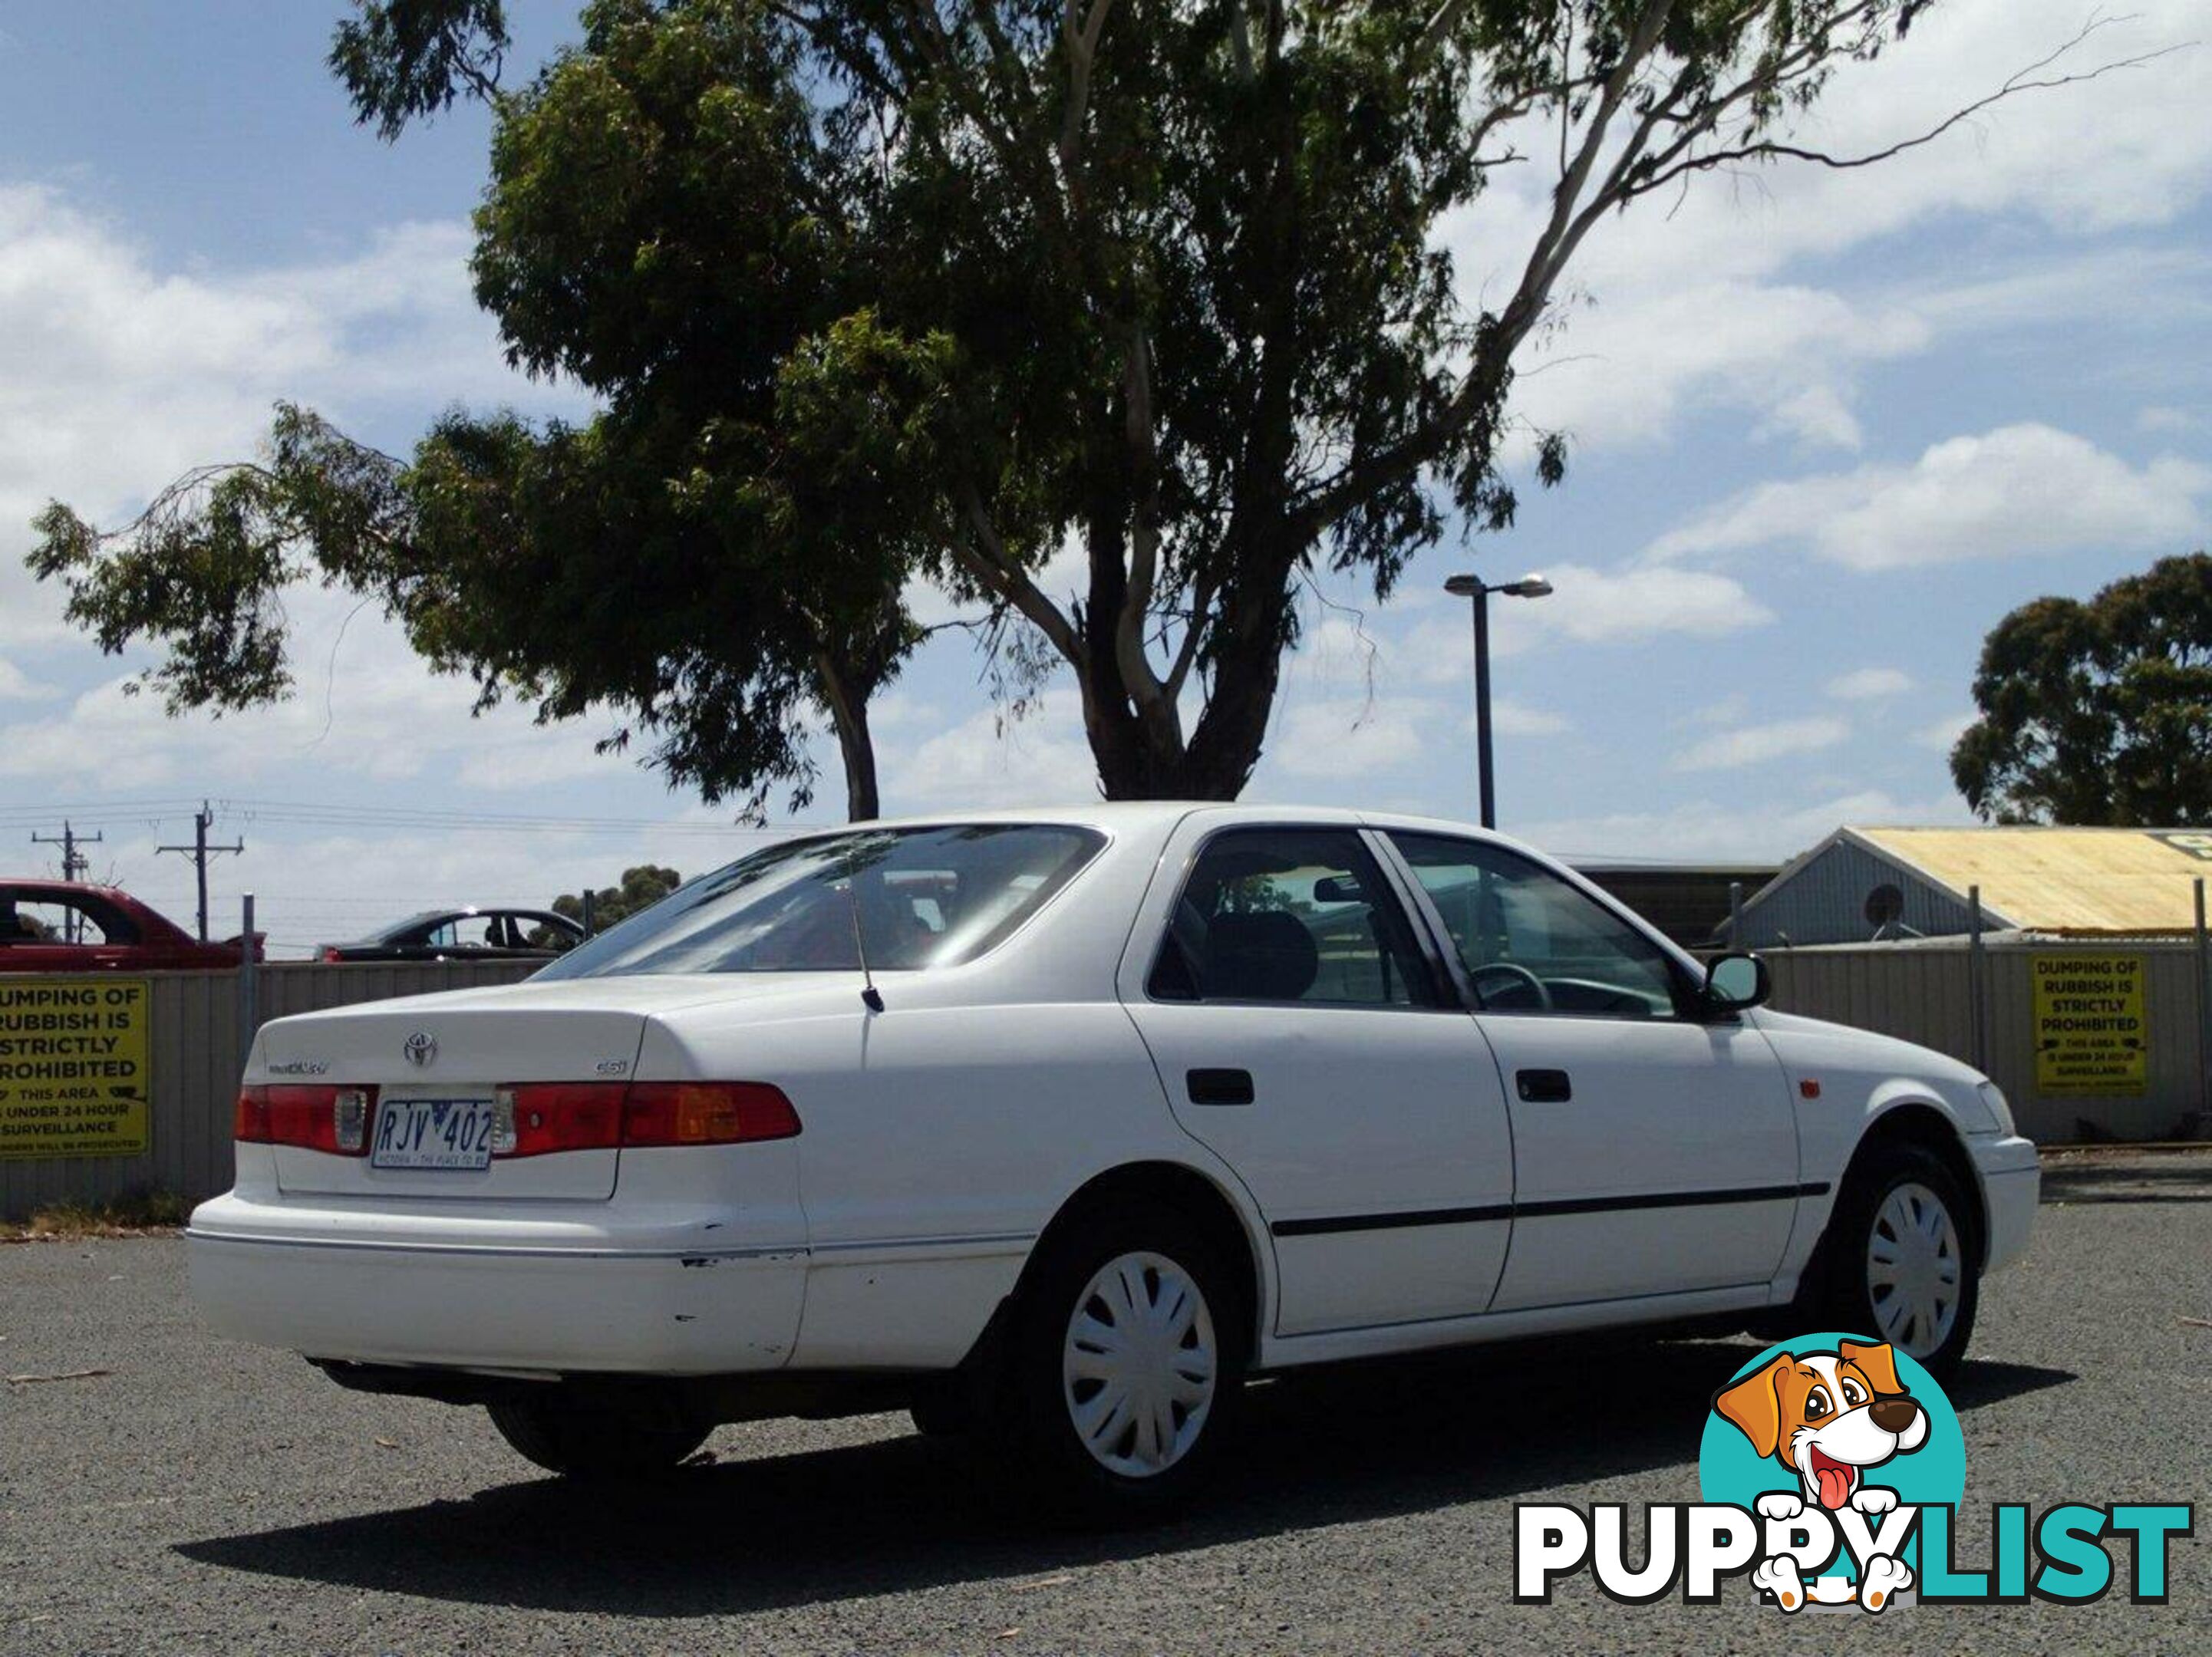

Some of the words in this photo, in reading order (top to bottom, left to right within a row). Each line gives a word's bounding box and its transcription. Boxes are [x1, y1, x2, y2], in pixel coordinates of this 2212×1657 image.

[2037, 961, 2111, 974] DUMPING
[2116, 960, 2138, 974] OF
[2044, 980, 2114, 993] RUBBISH
[2118, 980, 2133, 993] IS
[0, 989, 97, 1007] UMPING
[105, 988, 140, 1005] OF
[2052, 999, 2126, 1013] STRICTLY
[108, 1012, 131, 1029] IS
[2042, 1018, 2138, 1031] PROHIBITED
[0, 1036, 119, 1056] STRICTLY
[0, 1059, 137, 1080] ROHIBITED
[18, 1088, 53, 1100] THIS
[58, 1086, 99, 1099] AREA
[6, 1105, 59, 1118] UNDER
[64, 1105, 81, 1117] 24
[85, 1104, 129, 1116] HOUR
[1, 1121, 117, 1135] SURVEILLANCE
[380, 1110, 430, 1151] RJV
[443, 1110, 493, 1152] 402
